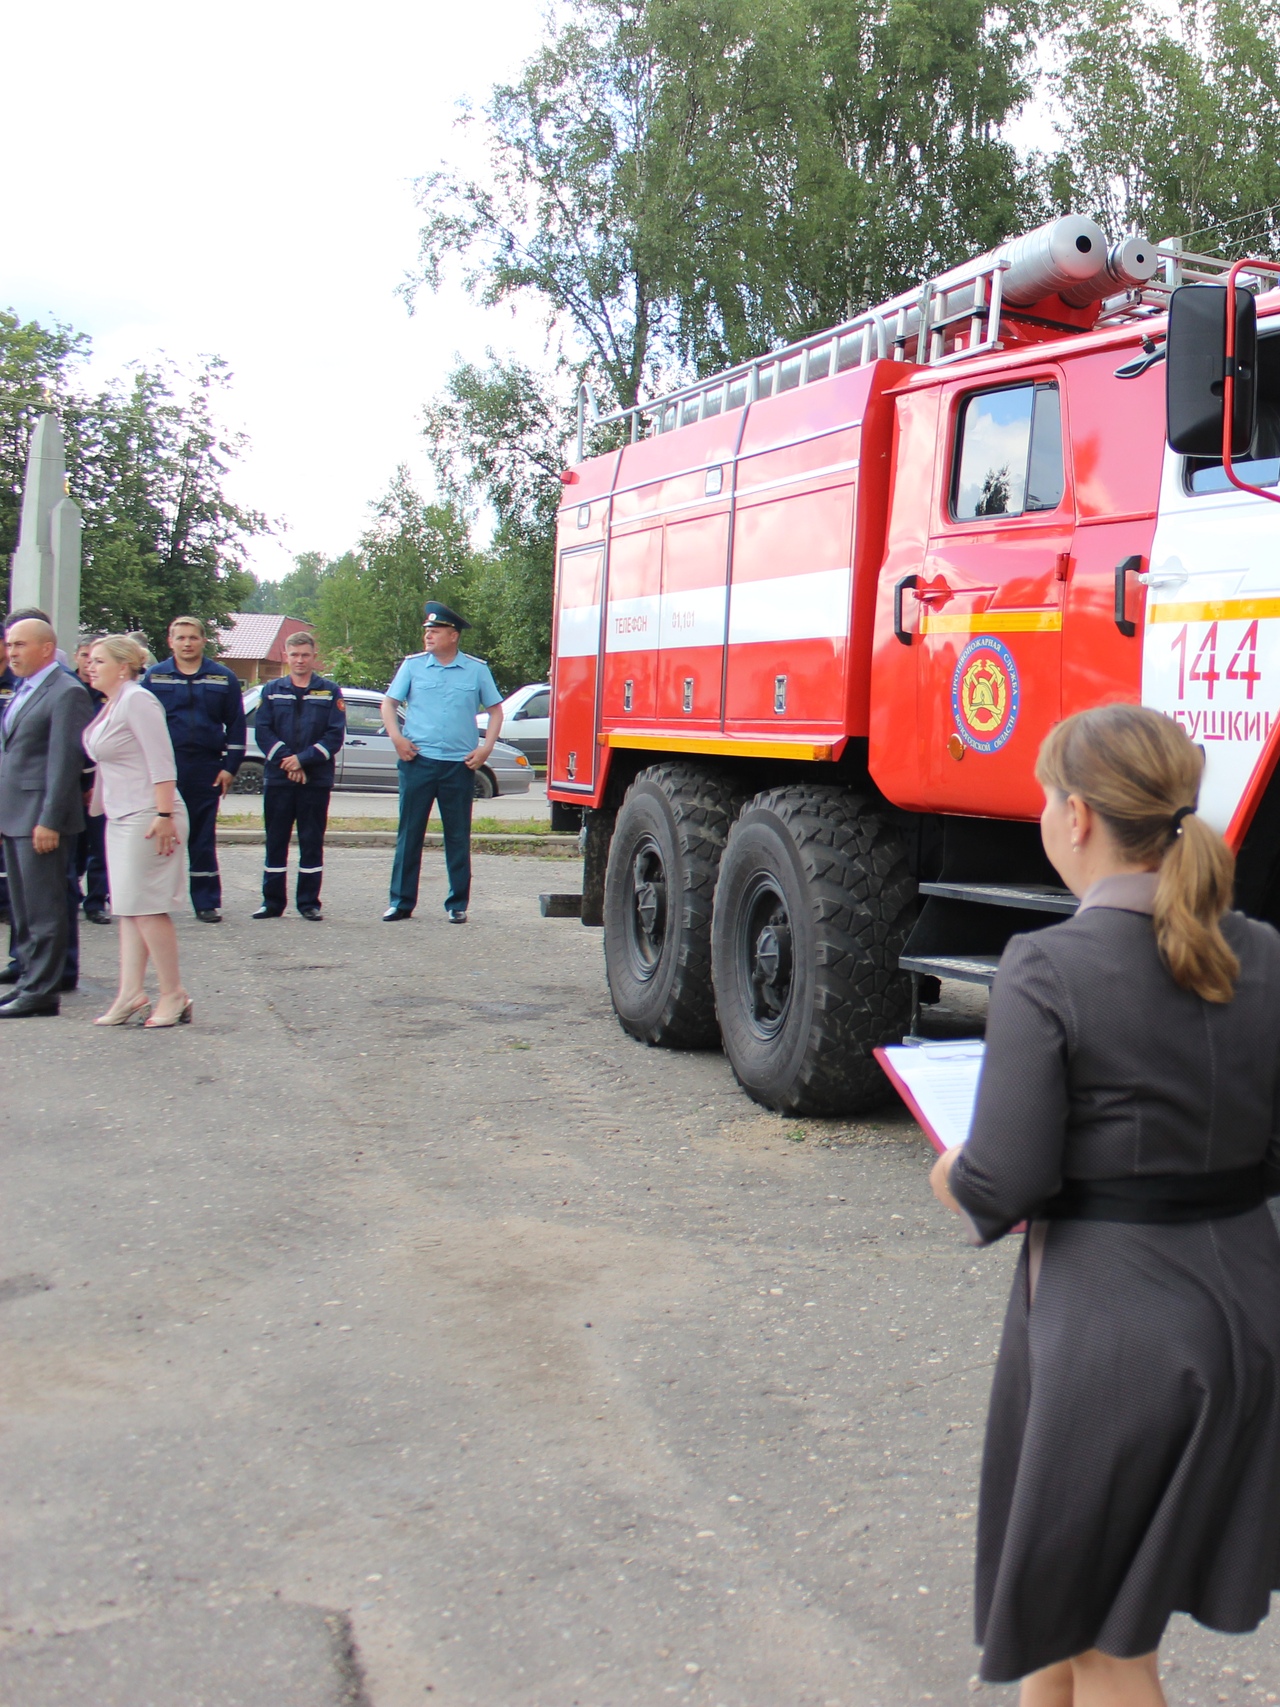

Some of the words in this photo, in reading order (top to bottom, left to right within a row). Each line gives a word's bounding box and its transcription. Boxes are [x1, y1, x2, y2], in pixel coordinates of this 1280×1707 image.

[615, 615, 648, 634] ТЕЛЕФОН
[952, 638, 1002, 695] ПРОТИВОПОЖАРНАЯ
[1003, 653, 1017, 695] СЛУЖБА
[1171, 620, 1261, 701] 144
[954, 714, 991, 751] ВОЛОГОДСКОЙ
[994, 715, 1015, 748] ОБЛАСТИ
